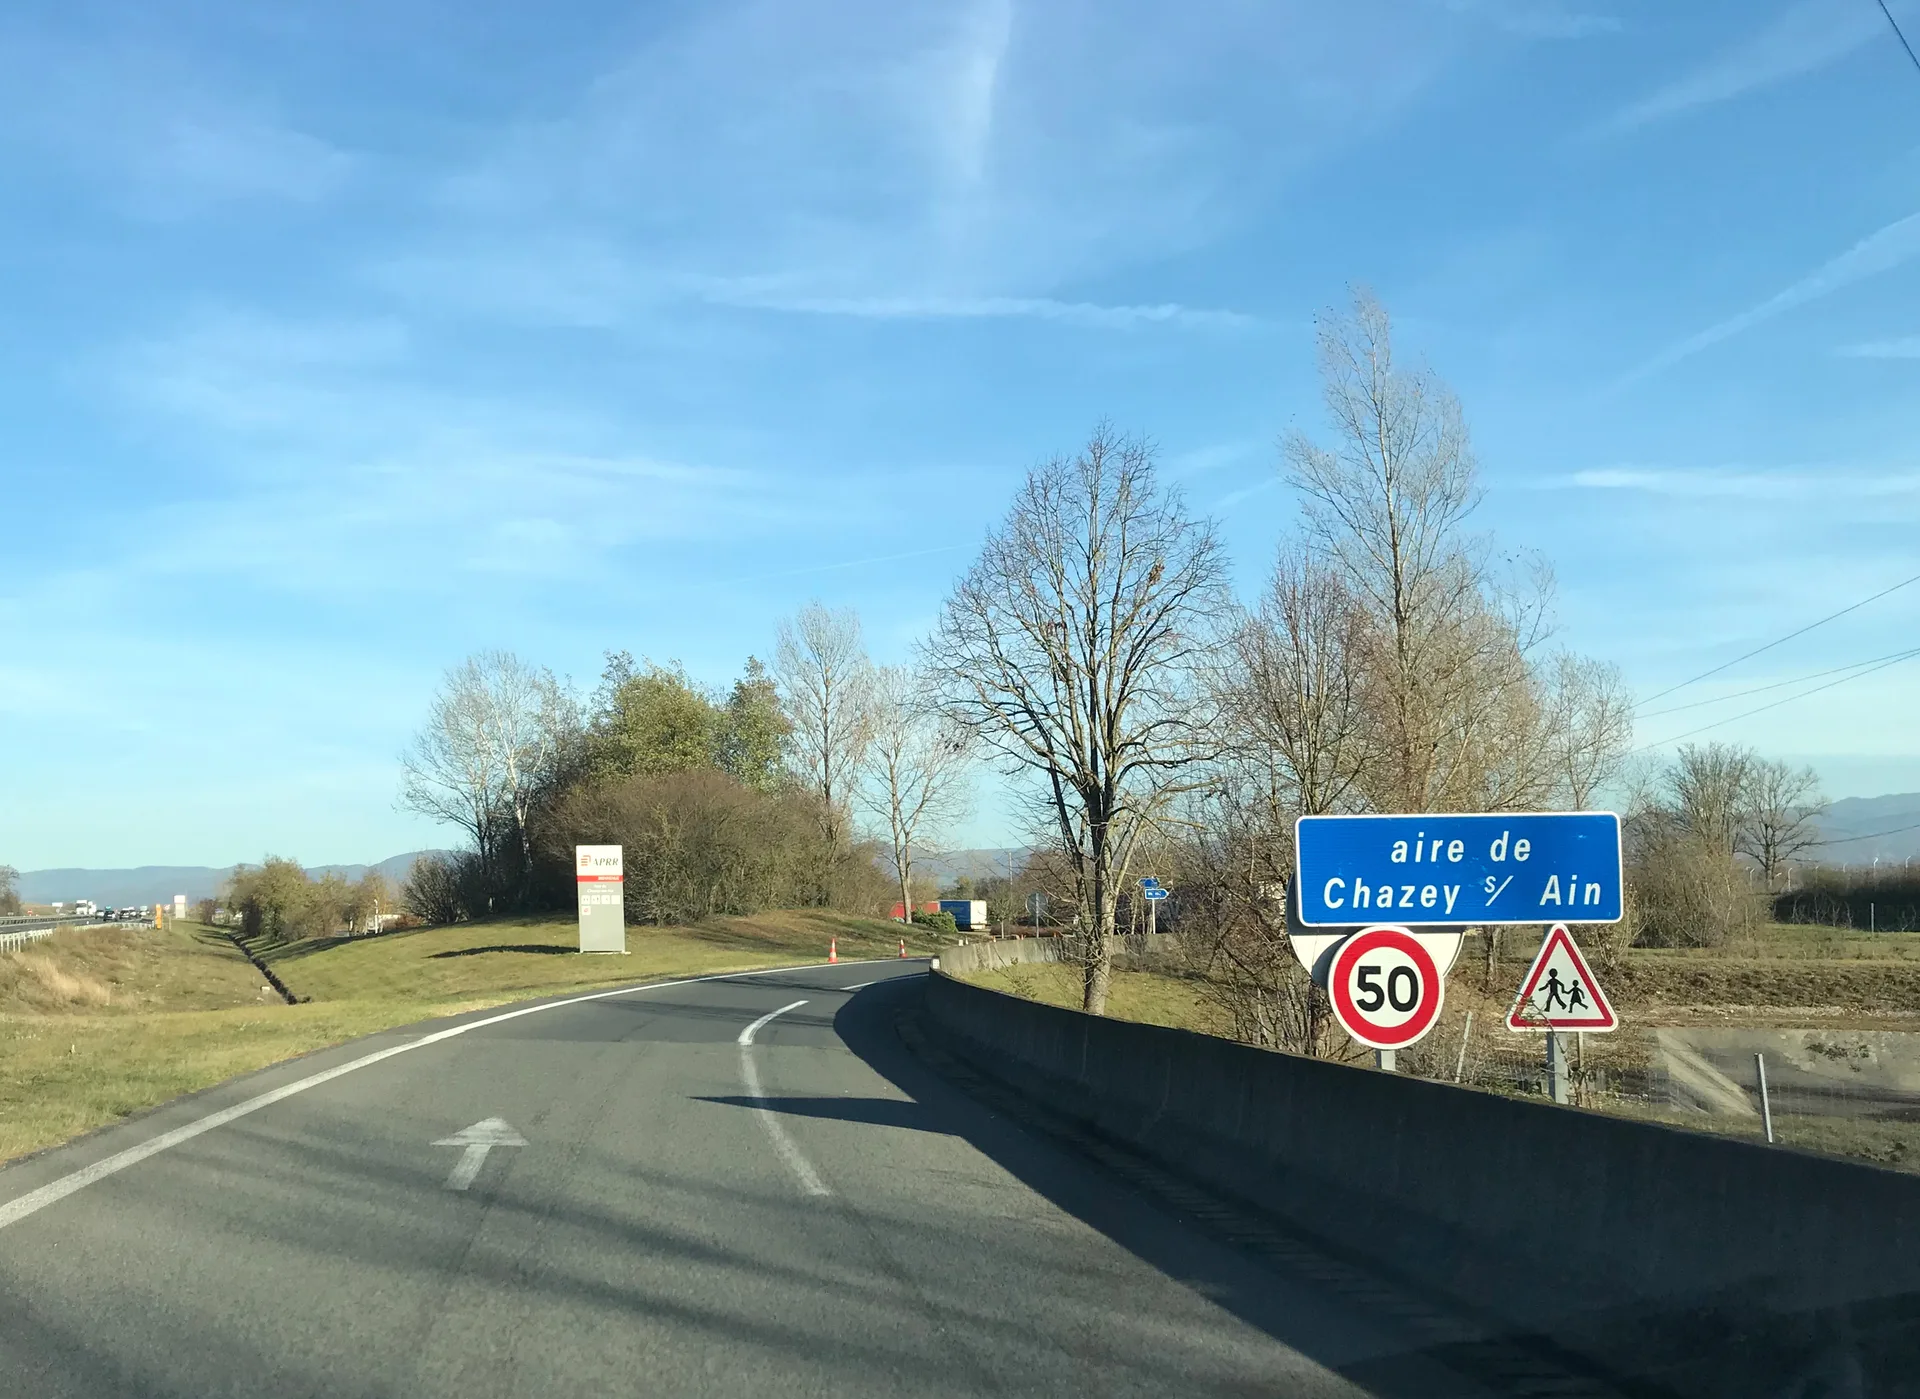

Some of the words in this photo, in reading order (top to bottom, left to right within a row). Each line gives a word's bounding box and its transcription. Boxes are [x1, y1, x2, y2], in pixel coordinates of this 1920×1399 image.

[1391, 831, 1465, 863] aire
[1490, 831, 1531, 862] de
[1323, 877, 1461, 914] Chazey
[1539, 874, 1602, 906] Ain
[1355, 965, 1419, 1012] 50
